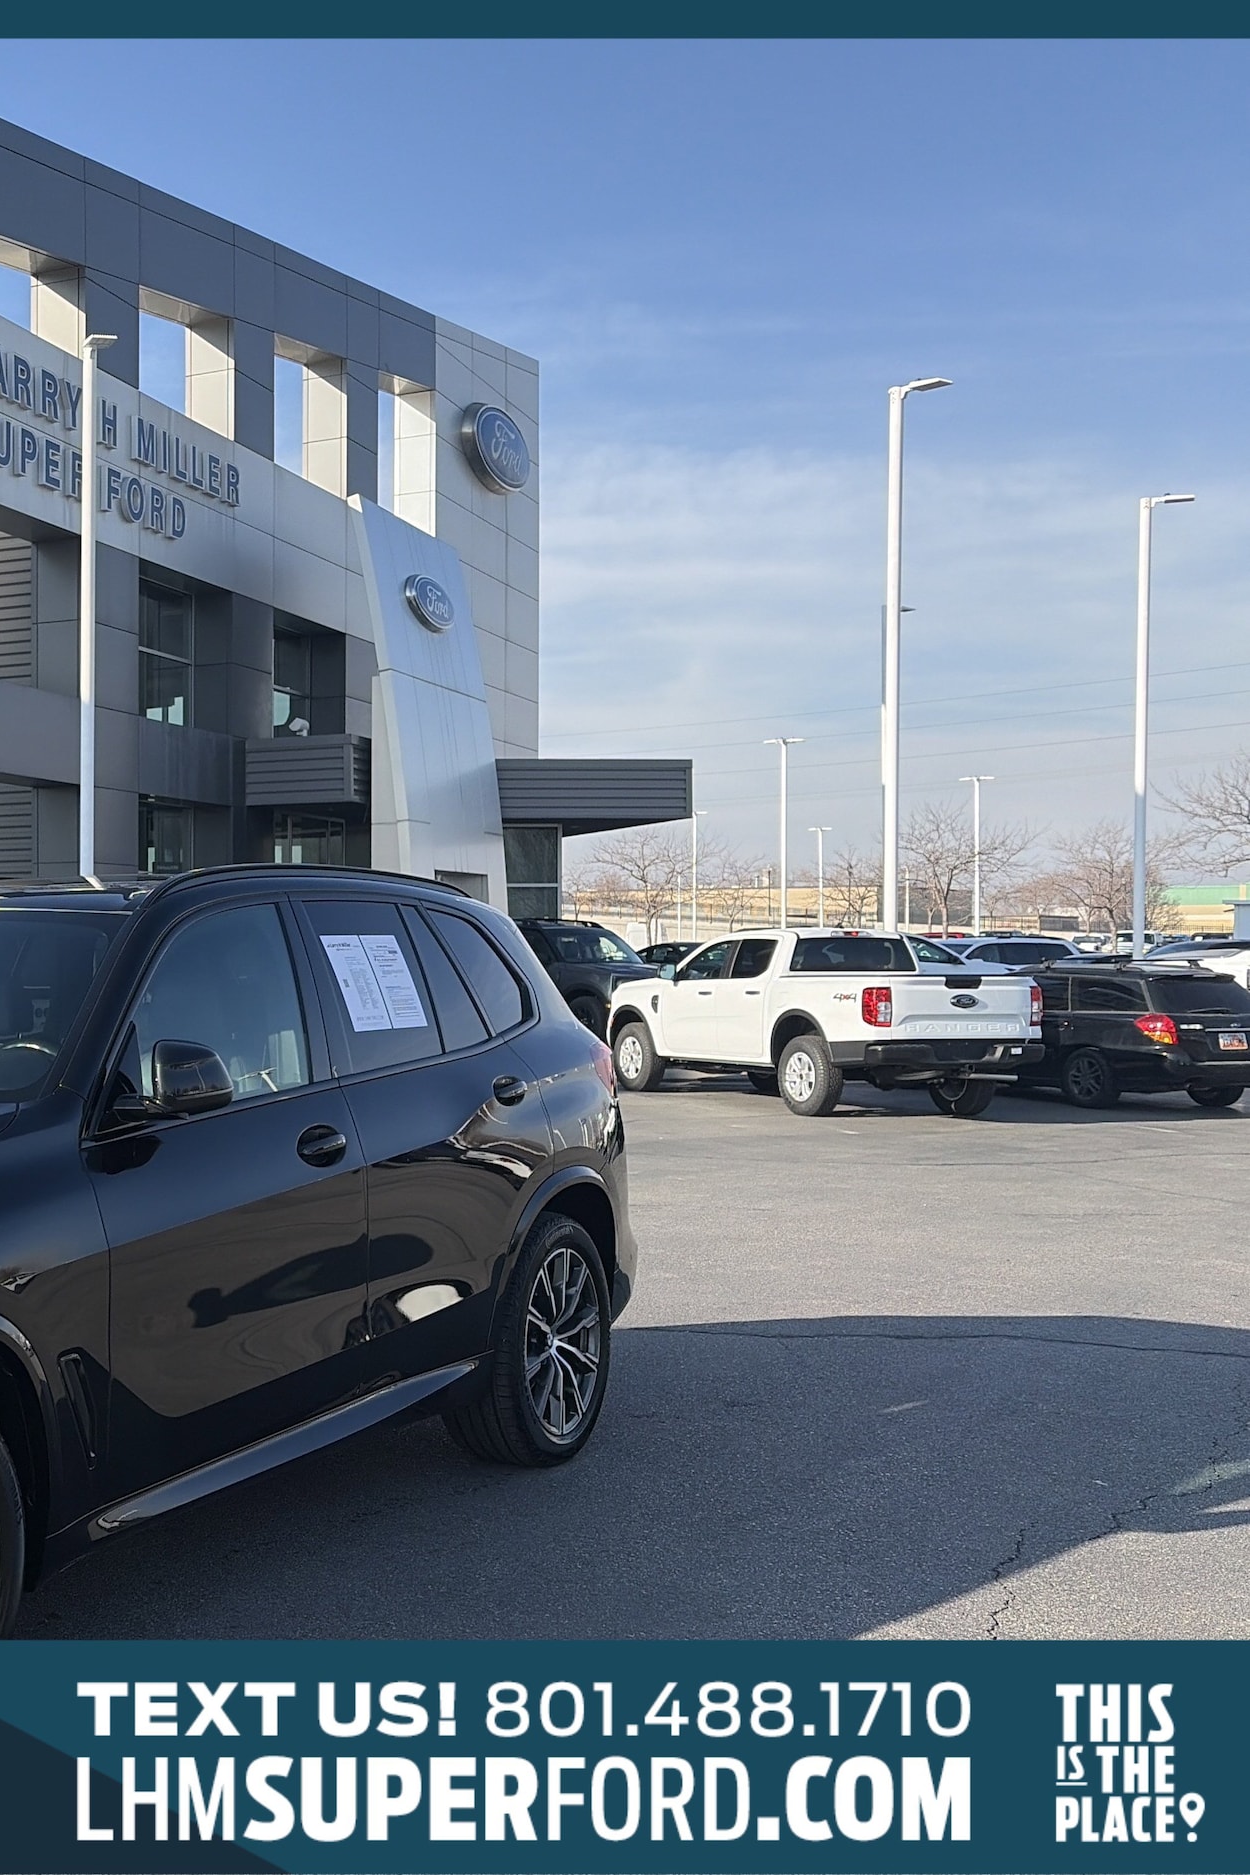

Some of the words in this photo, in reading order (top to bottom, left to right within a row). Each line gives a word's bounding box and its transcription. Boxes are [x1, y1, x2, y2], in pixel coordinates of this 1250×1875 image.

[97, 397, 118, 449] H
[130, 415, 240, 507] MILLER
[490, 420, 523, 476] Ford
[100, 465, 186, 539] FORD
[426, 584, 449, 619] Ford
[905, 1023, 1020, 1032] RANGER
